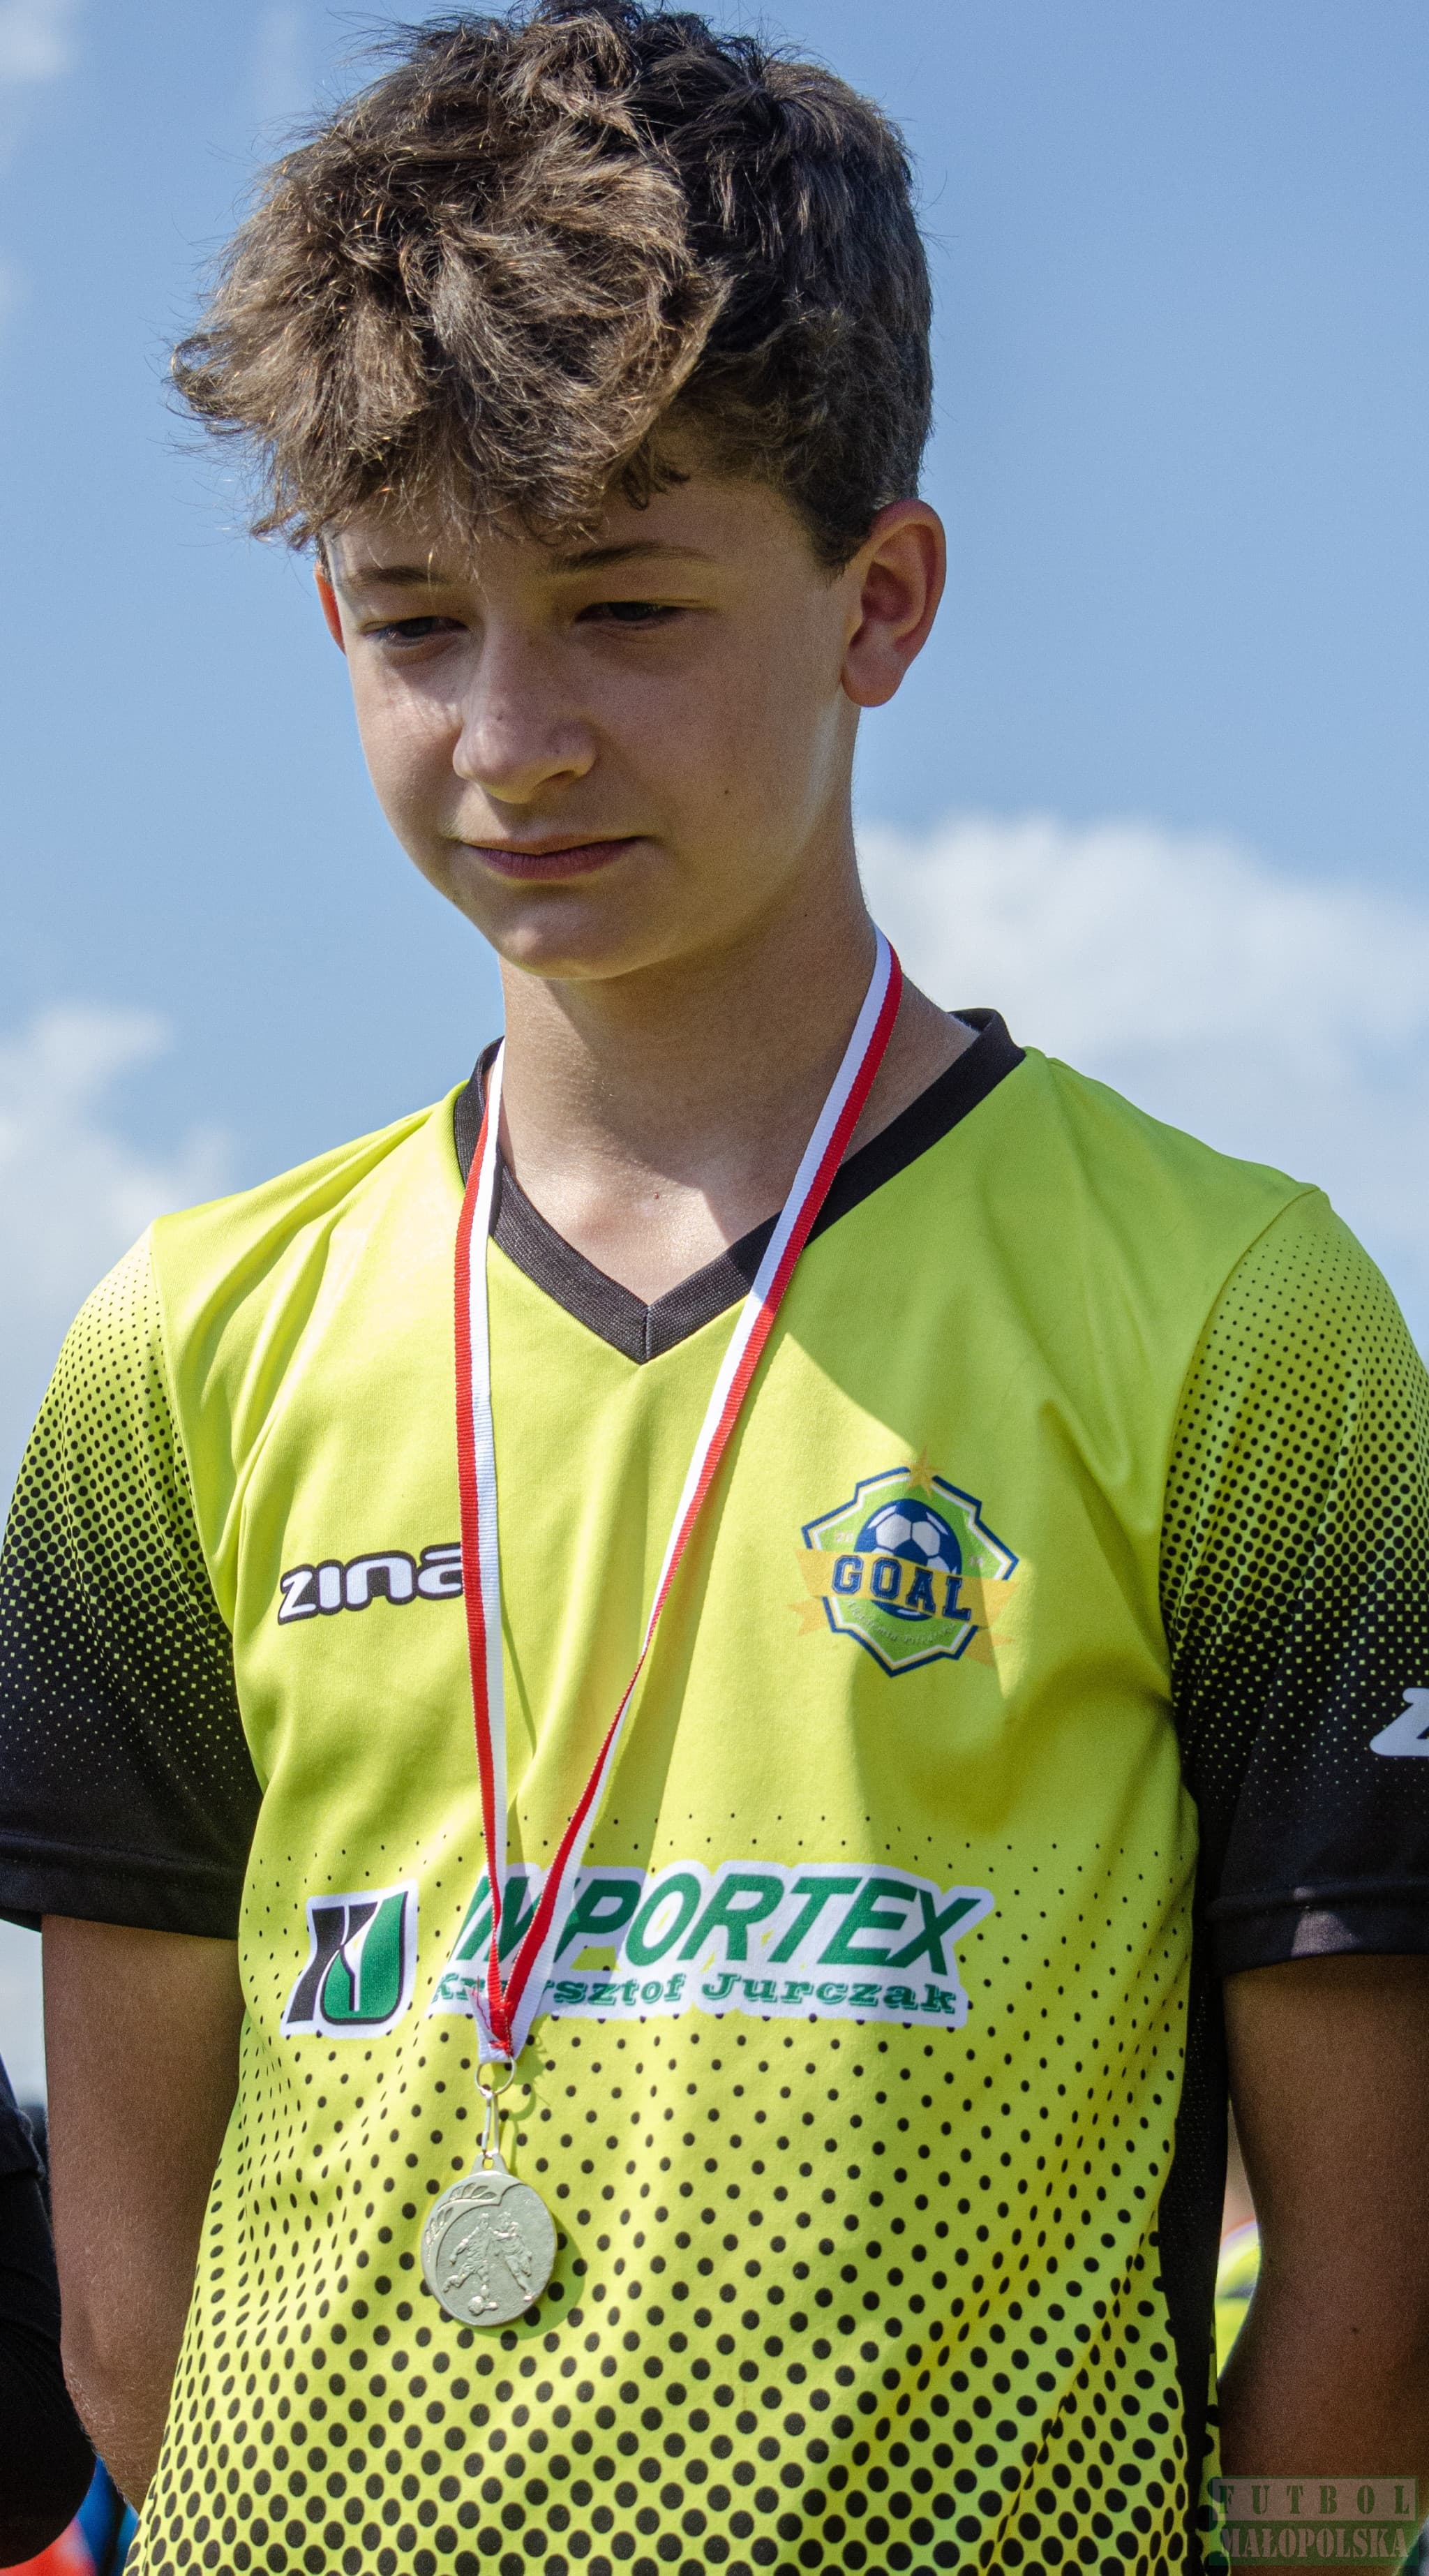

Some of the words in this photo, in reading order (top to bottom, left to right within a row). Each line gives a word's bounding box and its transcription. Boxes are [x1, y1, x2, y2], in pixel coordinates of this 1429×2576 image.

[831, 1555, 971, 1621] GOAL
[431, 1972, 686, 2007] Krsztof
[701, 1972, 958, 2015] Jurczak
